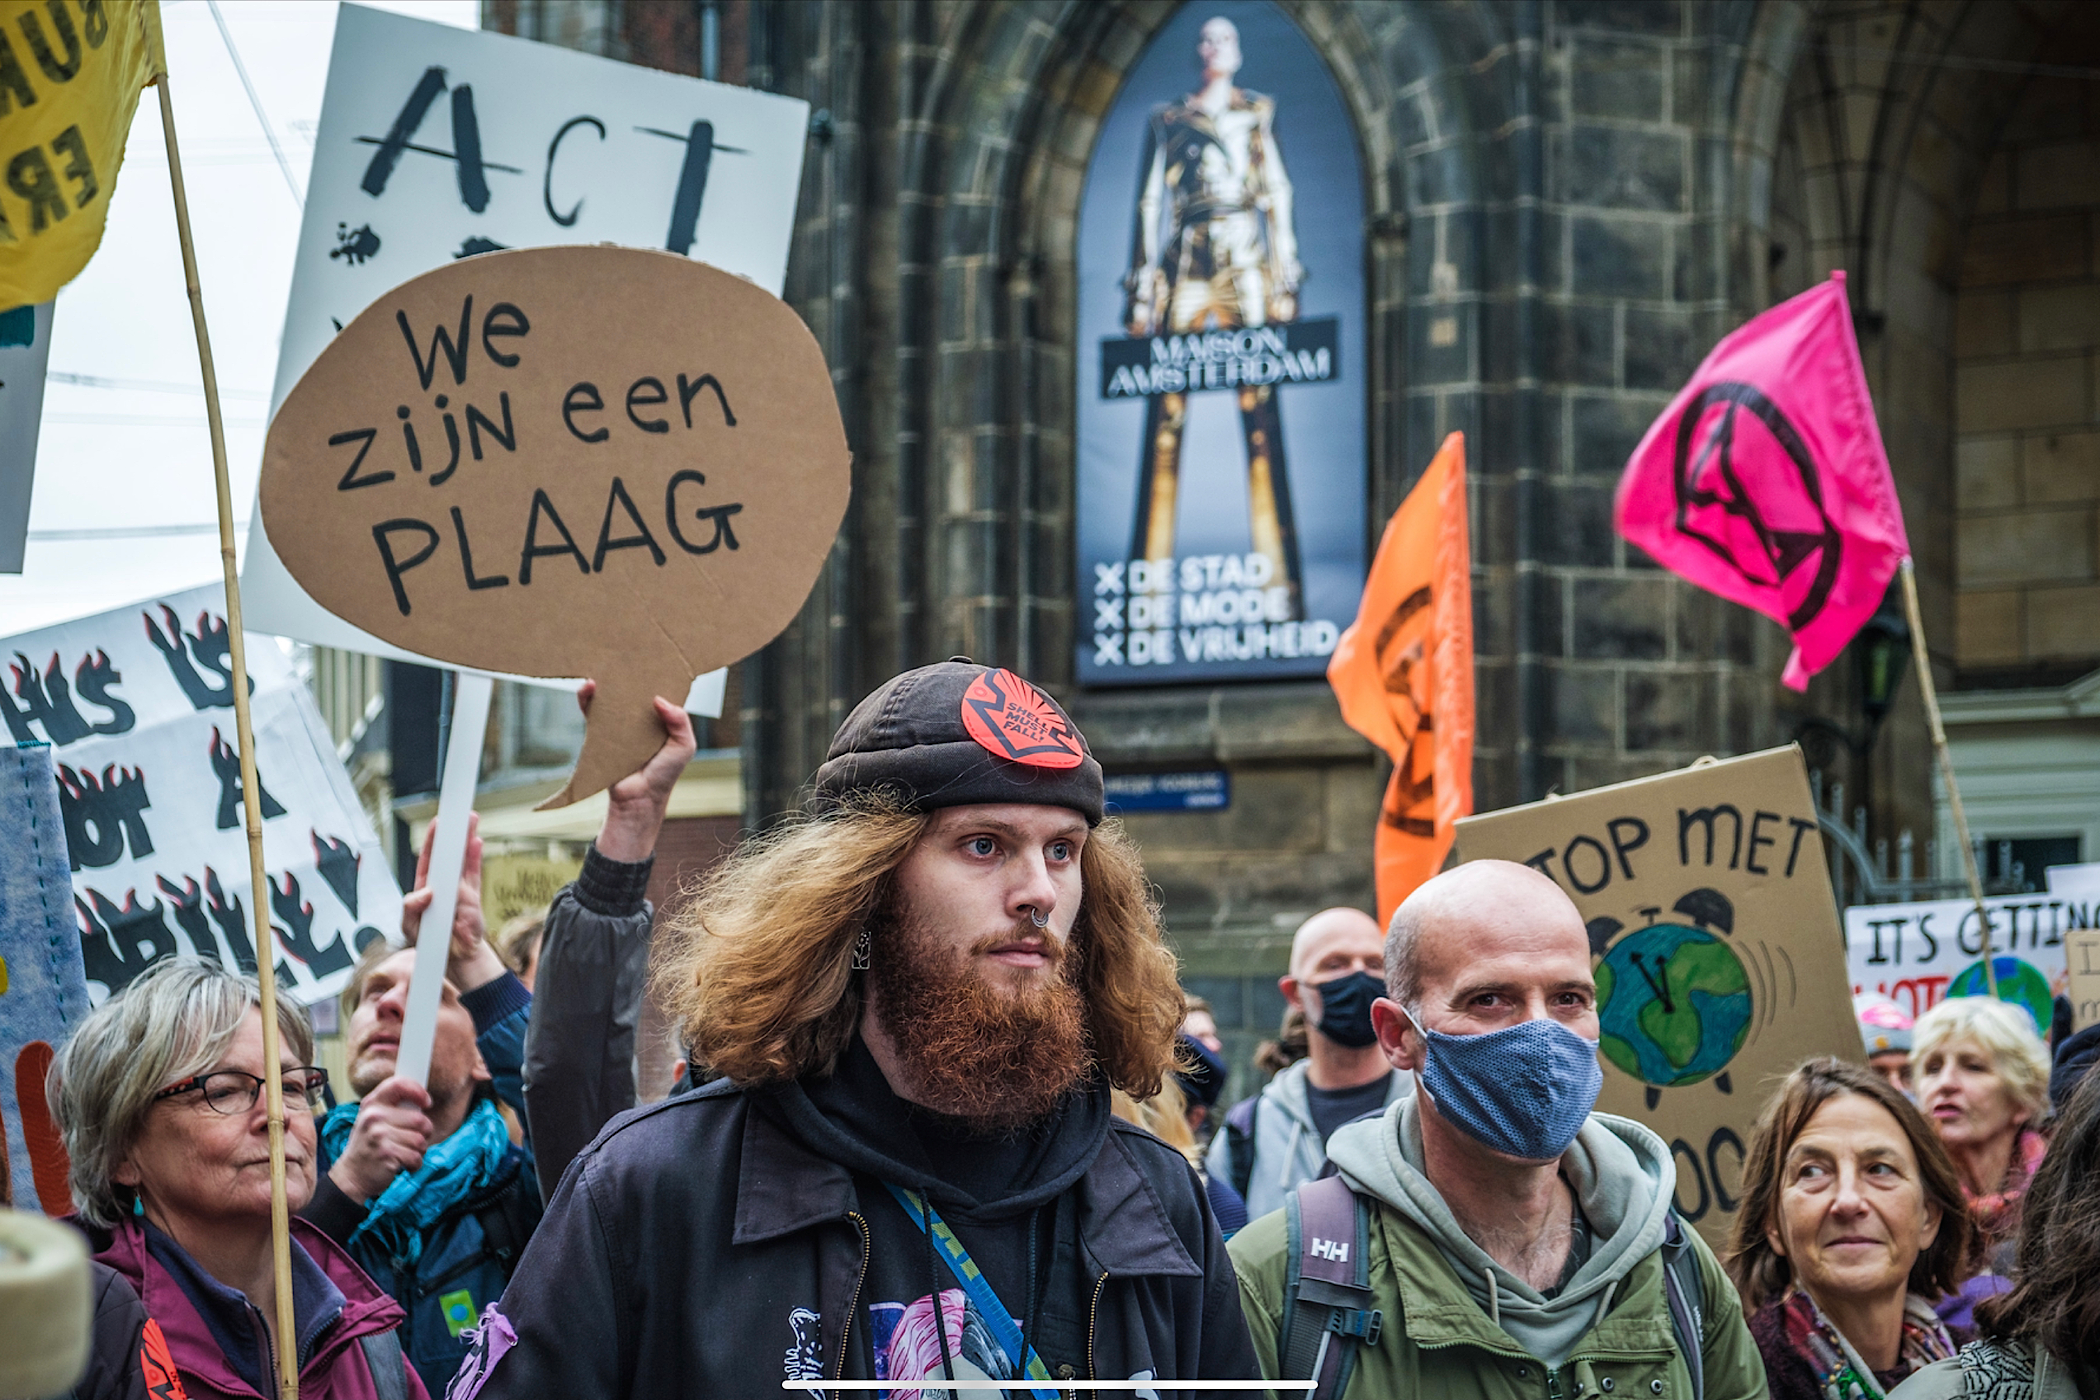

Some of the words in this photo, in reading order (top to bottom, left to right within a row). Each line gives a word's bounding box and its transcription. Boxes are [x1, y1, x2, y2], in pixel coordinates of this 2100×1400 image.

[353, 65, 752, 257] ACT
[396, 294, 530, 391] We
[1151, 327, 1287, 364] MAISON
[1107, 347, 1331, 397] AMSTERDAM
[562, 373, 737, 443] een
[372, 469, 743, 616] PLAAG
[1128, 560, 1176, 594] DE
[1180, 552, 1274, 593] STAD
[1128, 594, 1176, 629] DE
[1180, 586, 1291, 626] MODE
[142, 602, 255, 710] IS
[1128, 630, 1177, 665] DE
[1179, 619, 1340, 663] VRIJHEID
[1003, 721, 1045, 743] FALL!
[1005, 711, 1048, 734] MUST
[1007, 702, 1048, 733] SHELL
[210, 725, 288, 829] A
[1867, 912, 1939, 966] IT'S
[1311, 1237, 1349, 1263] HH
